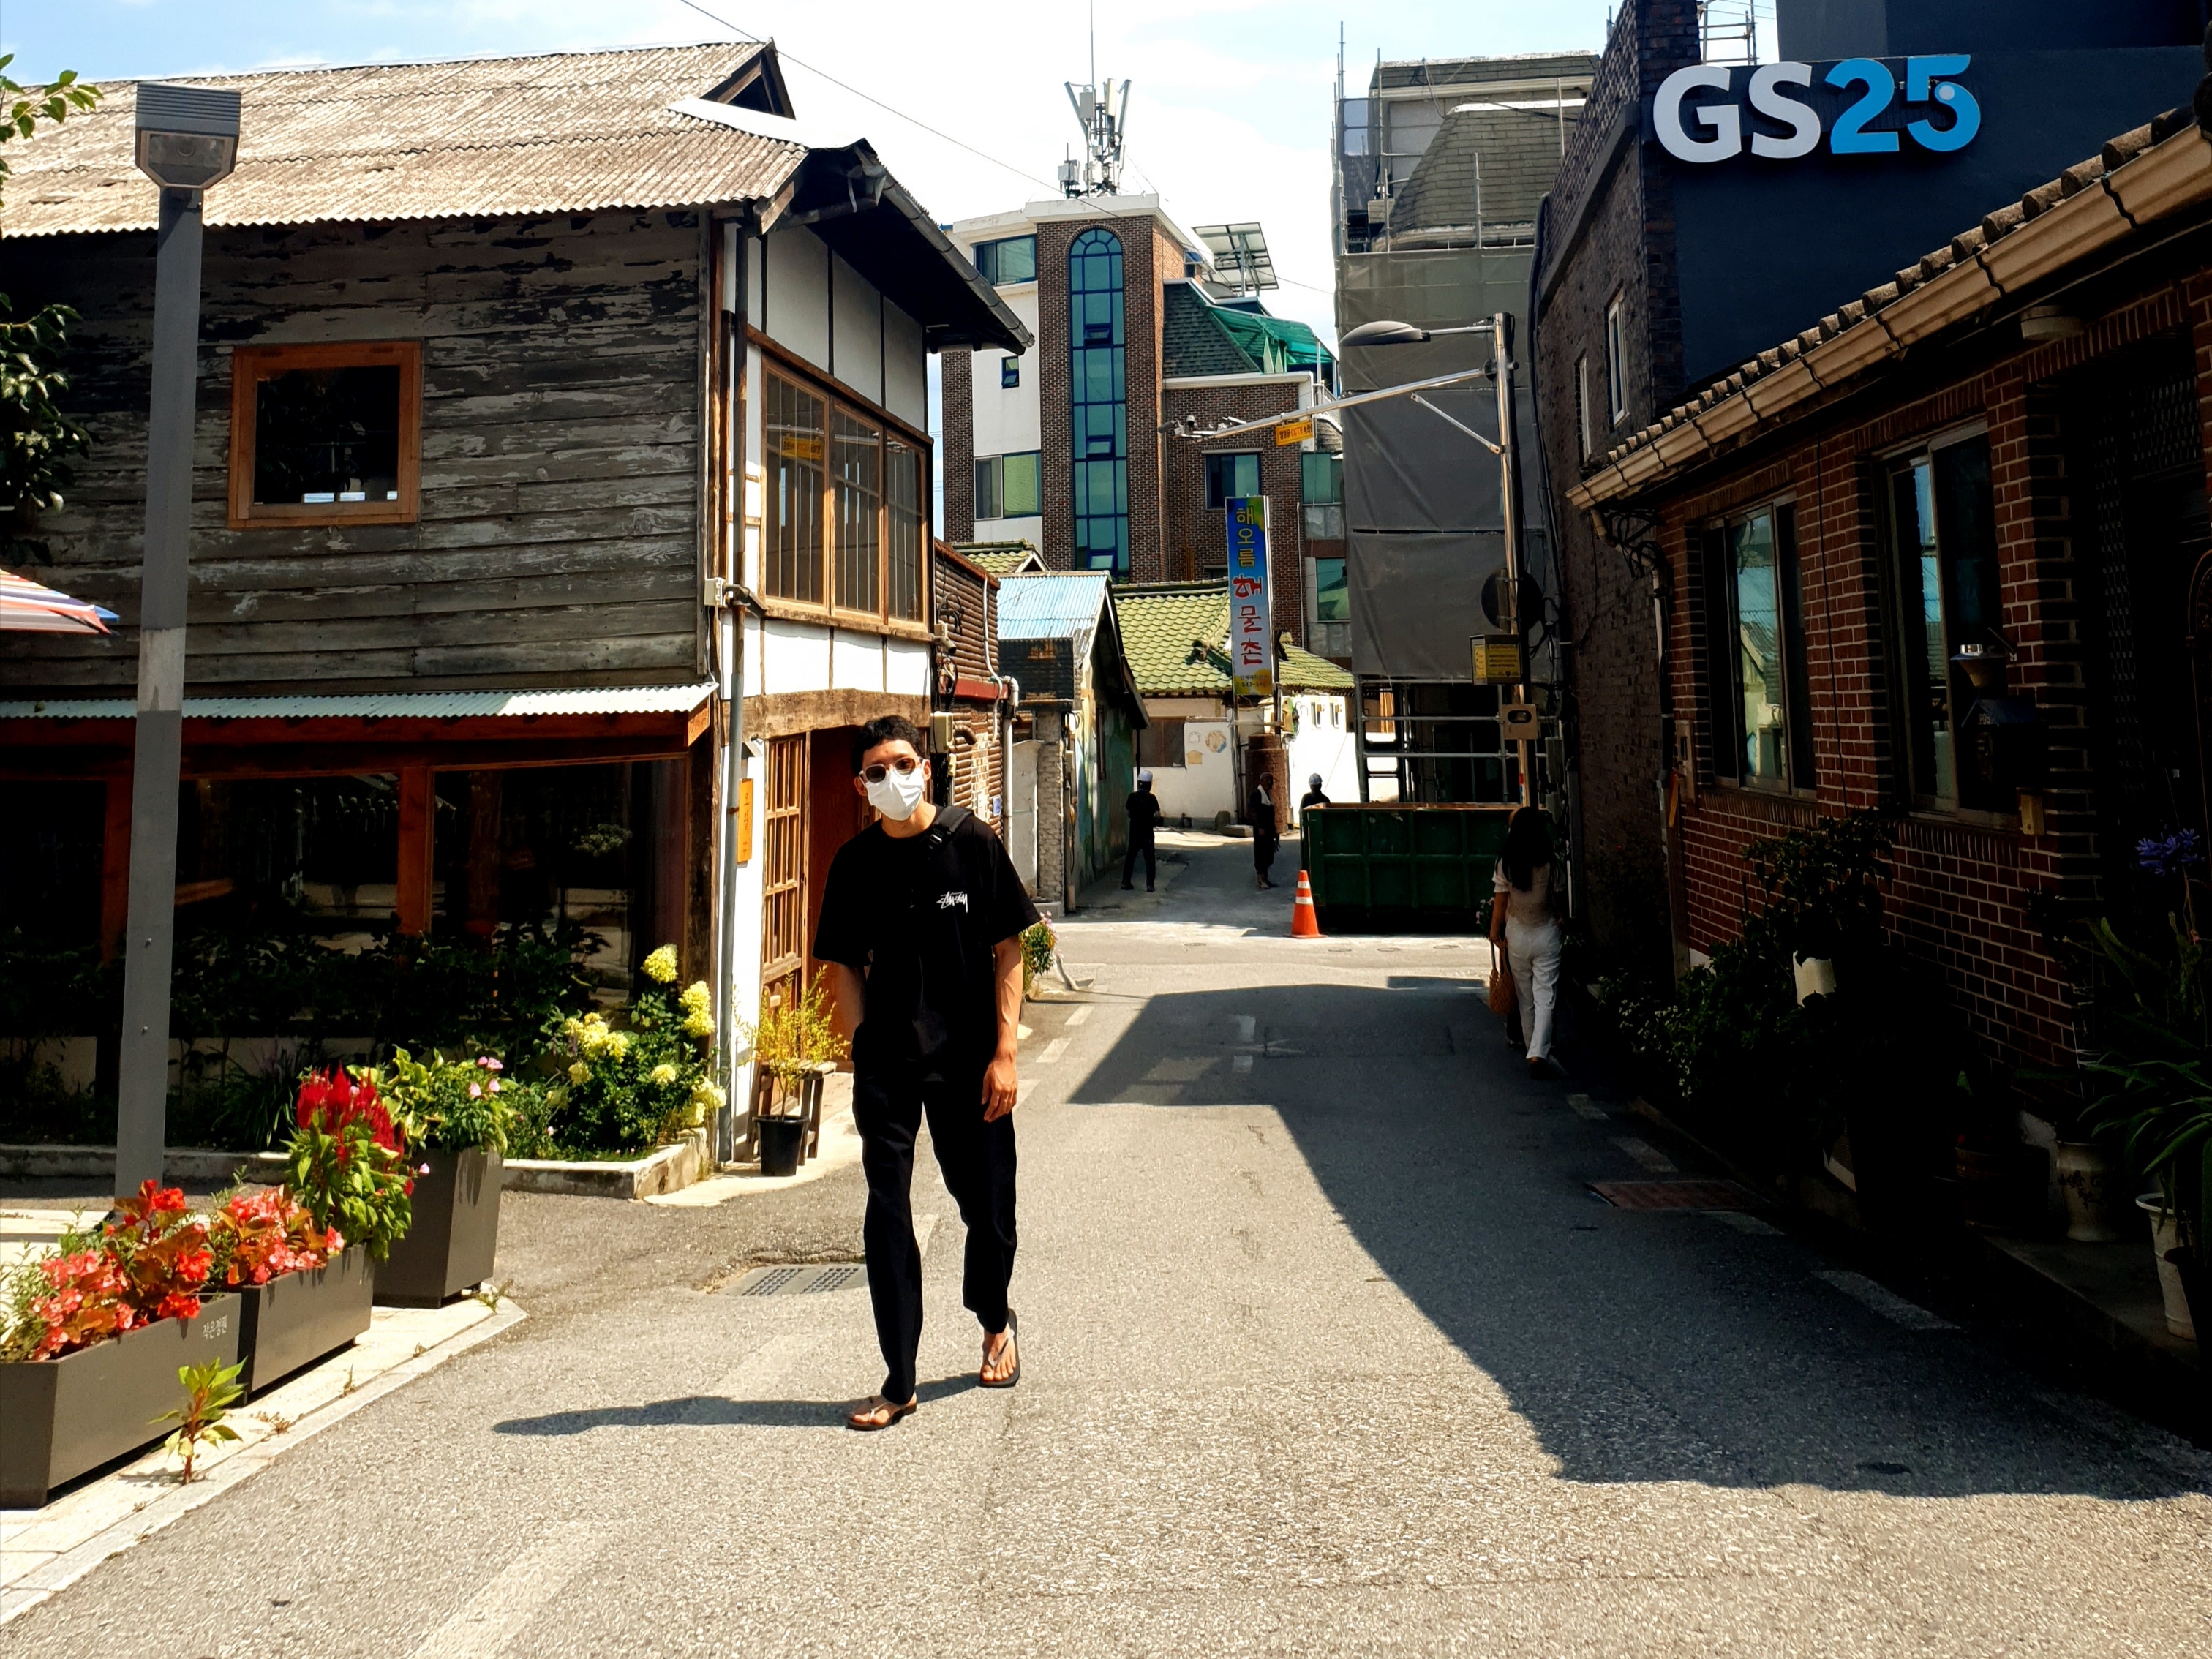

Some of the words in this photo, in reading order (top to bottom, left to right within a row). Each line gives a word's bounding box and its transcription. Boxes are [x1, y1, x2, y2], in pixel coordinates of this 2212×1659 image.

[1652, 53, 1981, 163] GS25
[1236, 505, 1255, 567] 해오름
[1232, 573, 1263, 666] 해물촌
